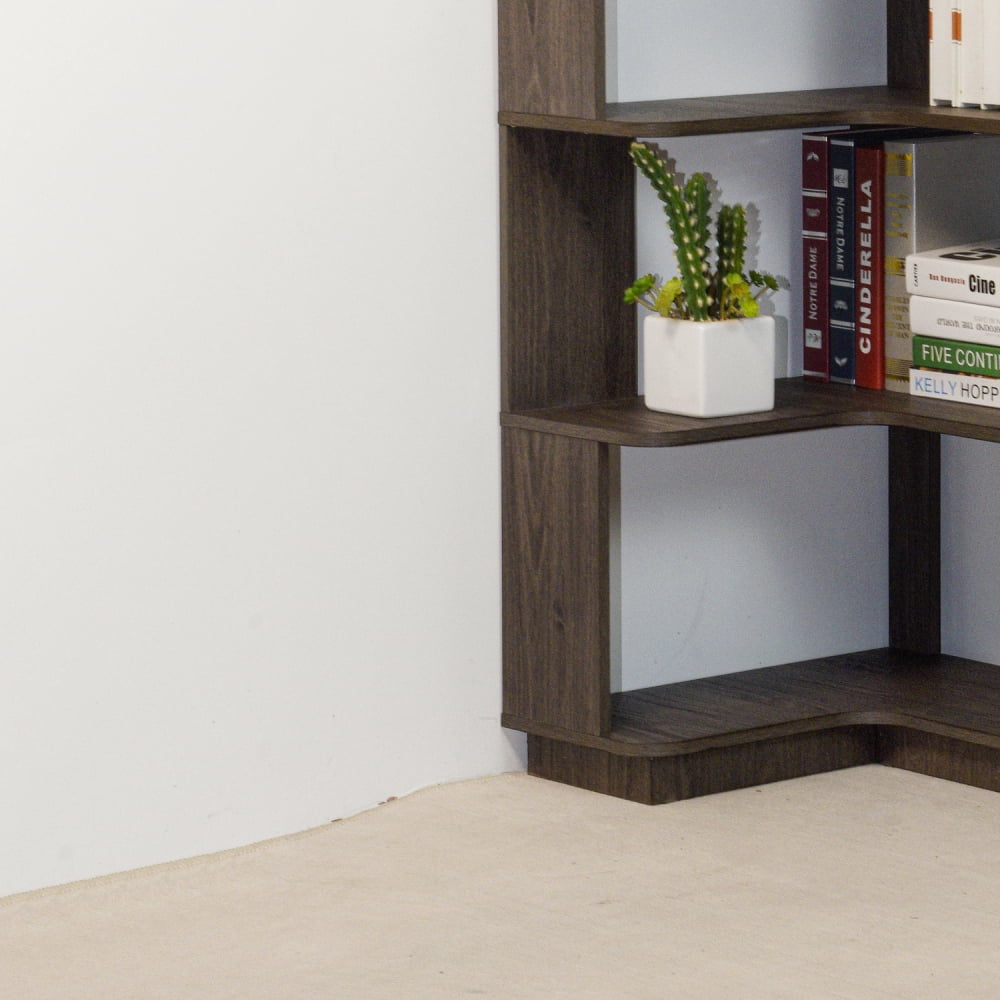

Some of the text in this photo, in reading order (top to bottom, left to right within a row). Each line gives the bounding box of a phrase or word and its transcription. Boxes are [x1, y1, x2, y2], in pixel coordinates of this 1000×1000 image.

[836, 197, 845, 271] NOTRE DAME
[809, 247, 818, 320] NOTRE DAME
[859, 180, 872, 354] CINDERELLA
[968, 274, 996, 295] Cine
[921, 344, 952, 364] FIVE
[914, 376, 957, 397] KELLY
